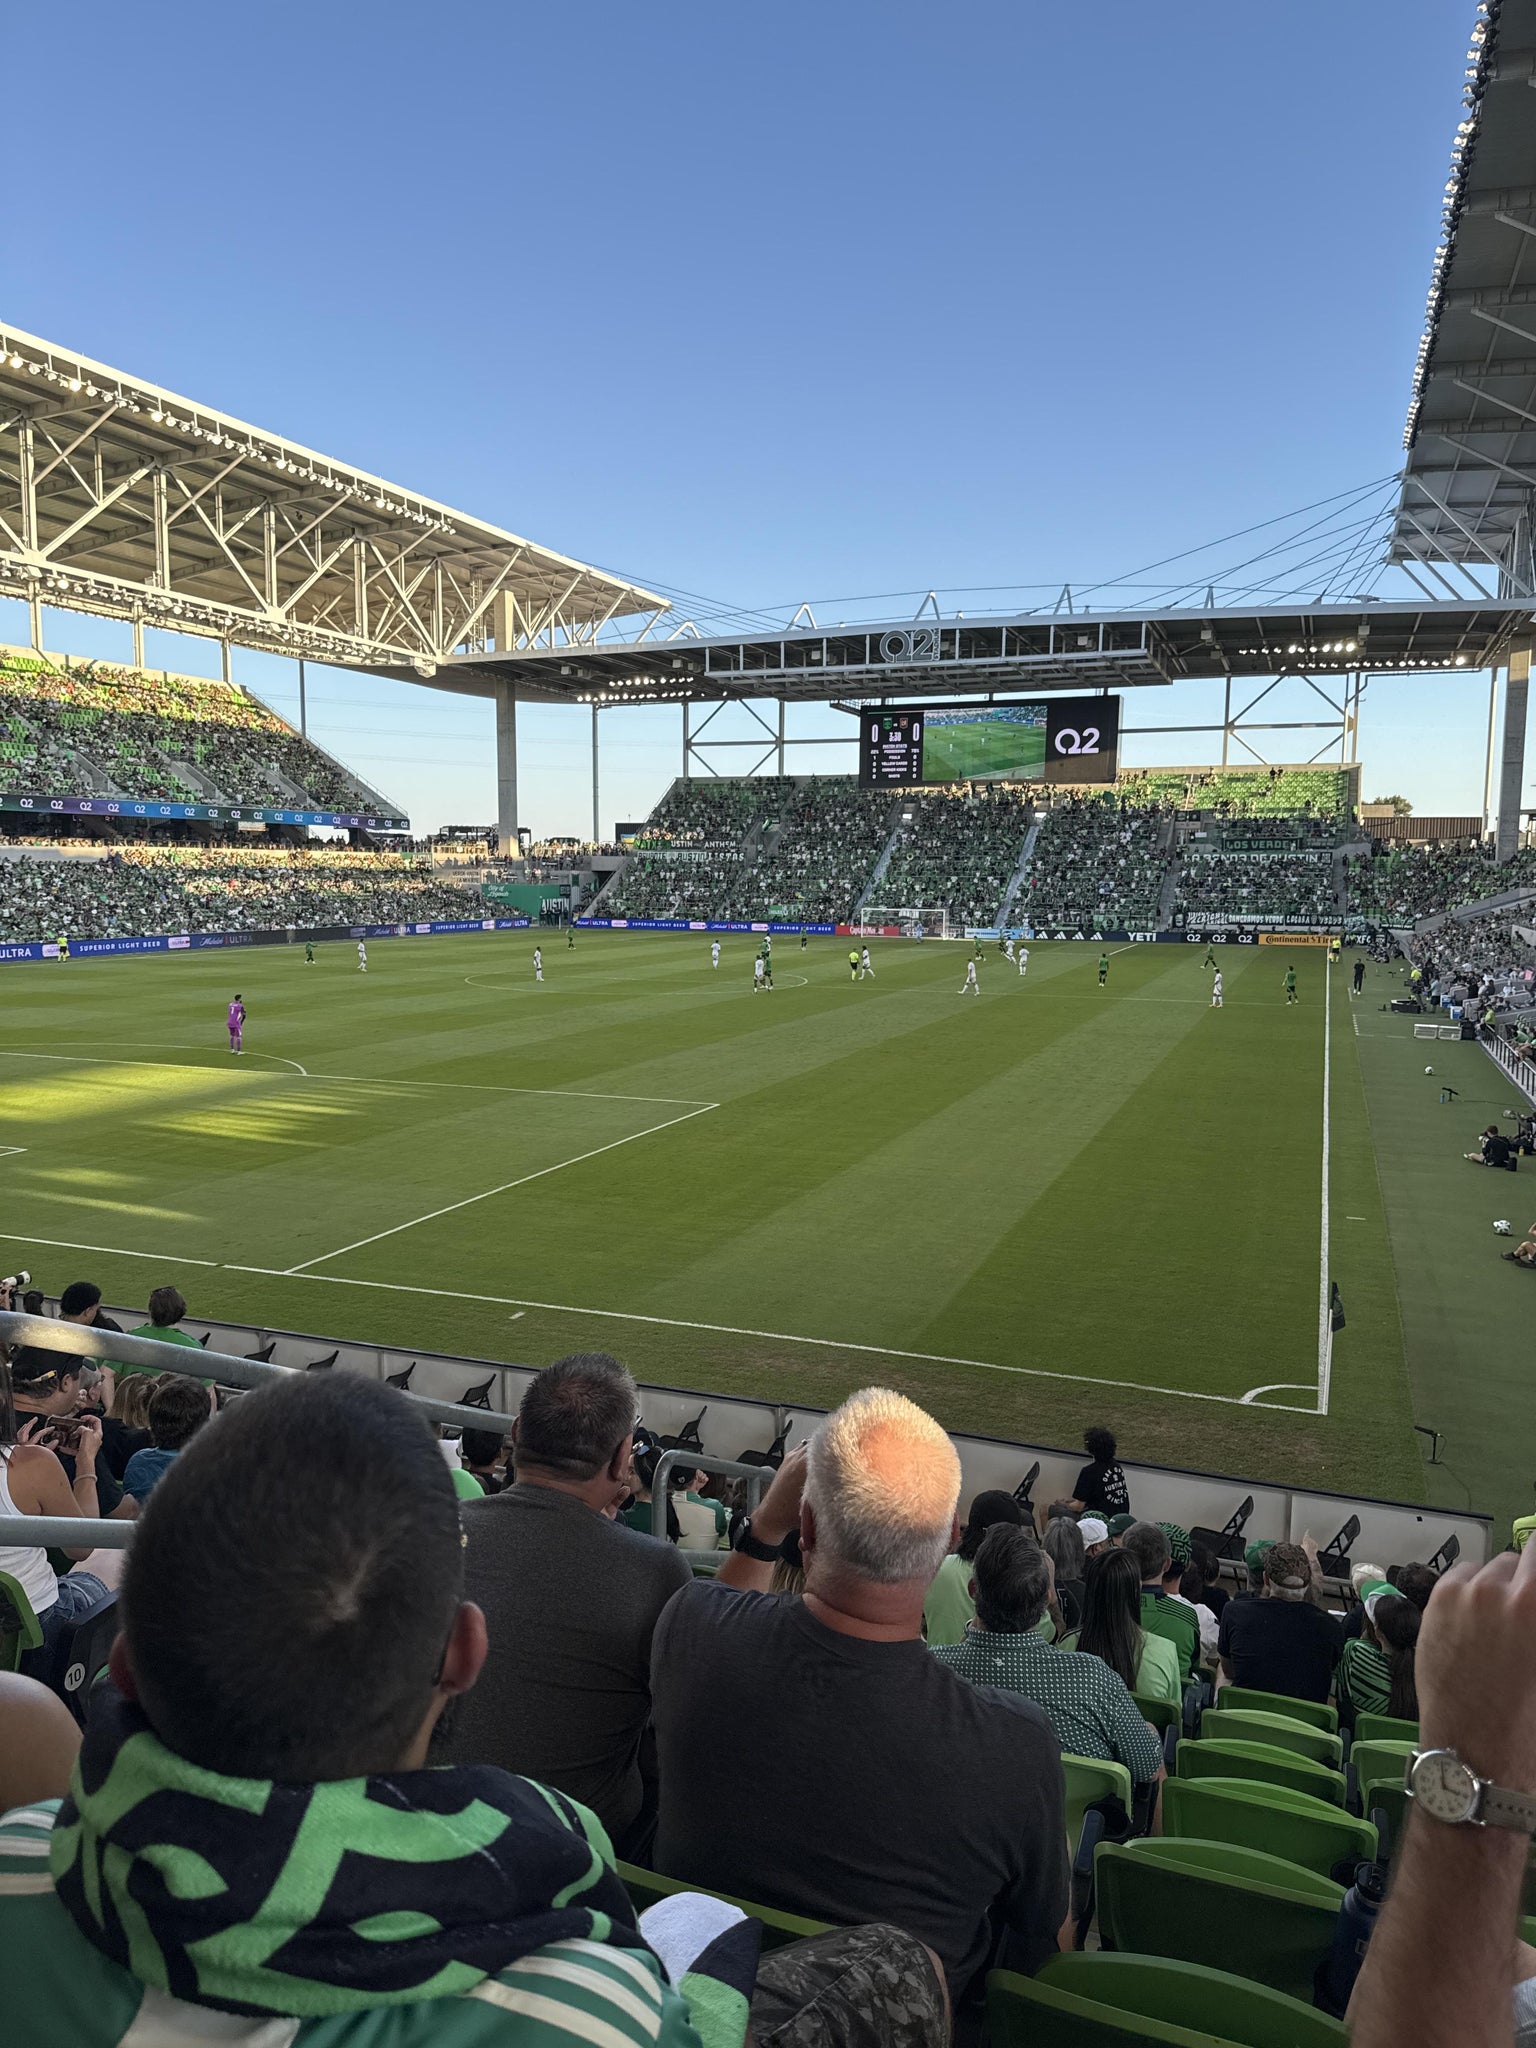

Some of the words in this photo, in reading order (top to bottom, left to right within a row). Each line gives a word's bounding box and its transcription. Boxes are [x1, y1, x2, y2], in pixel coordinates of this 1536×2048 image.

[880, 629, 932, 663] Q2
[1054, 727, 1100, 754] Q2
[20, 798, 33, 808] Q2
[51, 800, 63, 810] Q2
[80, 802, 92, 811] Q2
[108, 803, 119, 812] Q2
[134, 805, 146, 814] Q2
[160, 806, 171, 815] Q2
[184, 807, 195, 816] Q2
[208, 809, 218, 818] Q2
[231, 810, 241, 819] Q2
[254, 811, 263, 820] Q2
[275, 813, 283, 821] Q2
[295, 814, 303, 822] Q2
[314, 815, 322, 823] Q2
[333, 816, 341, 824] Q2
[351, 818, 358, 826] Q2
[368, 818, 376, 826] Q2
[1226, 840, 1248, 849] LOS
[1251, 840, 1292, 849] VERDE
[229, 935, 253, 944] ULTRA
[1128, 933, 1156, 941] YETI
[1187, 933, 1200, 942] Q2
[1212, 934, 1226, 943] Q2
[1238, 935, 1252, 943] Q2
[1265, 935, 1310, 944] Continental
[80, 943, 115, 952] SUPERIOR
[69, 1669, 81, 1685] 10
